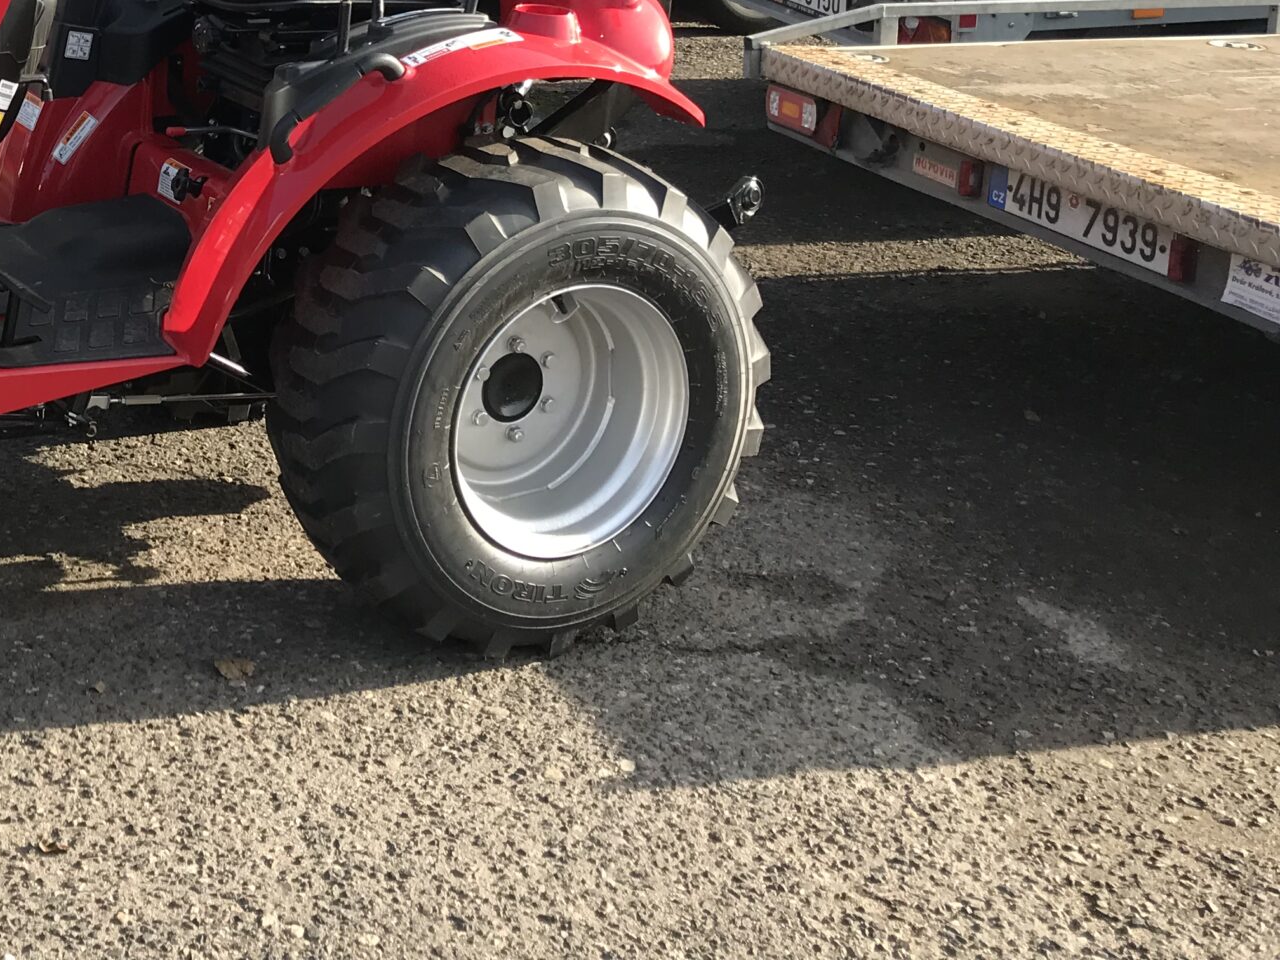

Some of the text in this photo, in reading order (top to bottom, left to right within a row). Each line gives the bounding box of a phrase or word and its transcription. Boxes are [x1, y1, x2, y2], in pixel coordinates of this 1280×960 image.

[914, 155, 956, 183] AUTOVIA
[992, 190, 1004, 204] CZ
[1011, 171, 1159, 263] 4H9 7939
[471, 558, 569, 604] TIRON
